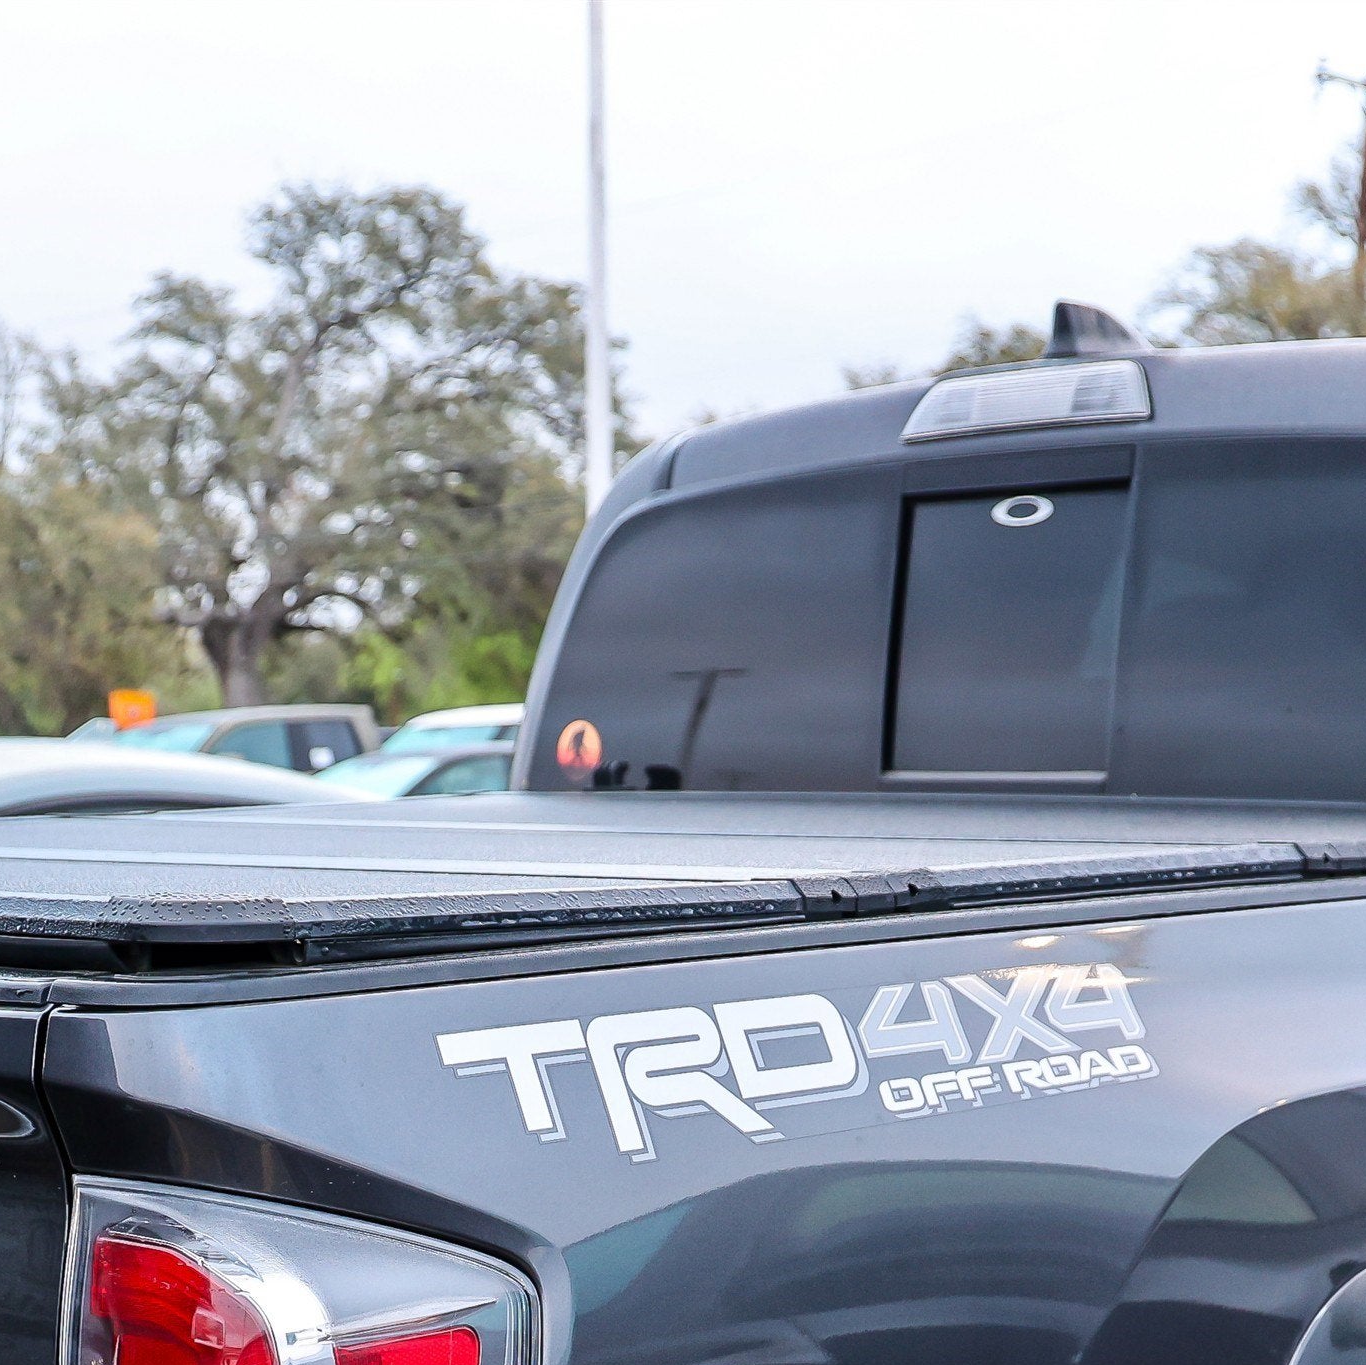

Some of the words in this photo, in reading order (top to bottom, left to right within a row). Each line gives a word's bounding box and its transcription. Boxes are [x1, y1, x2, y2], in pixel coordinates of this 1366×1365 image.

[435, 993, 870, 1165] TRD
[878, 1065, 1002, 1119] OFF
[1020, 1044, 1160, 1100] ROAD
